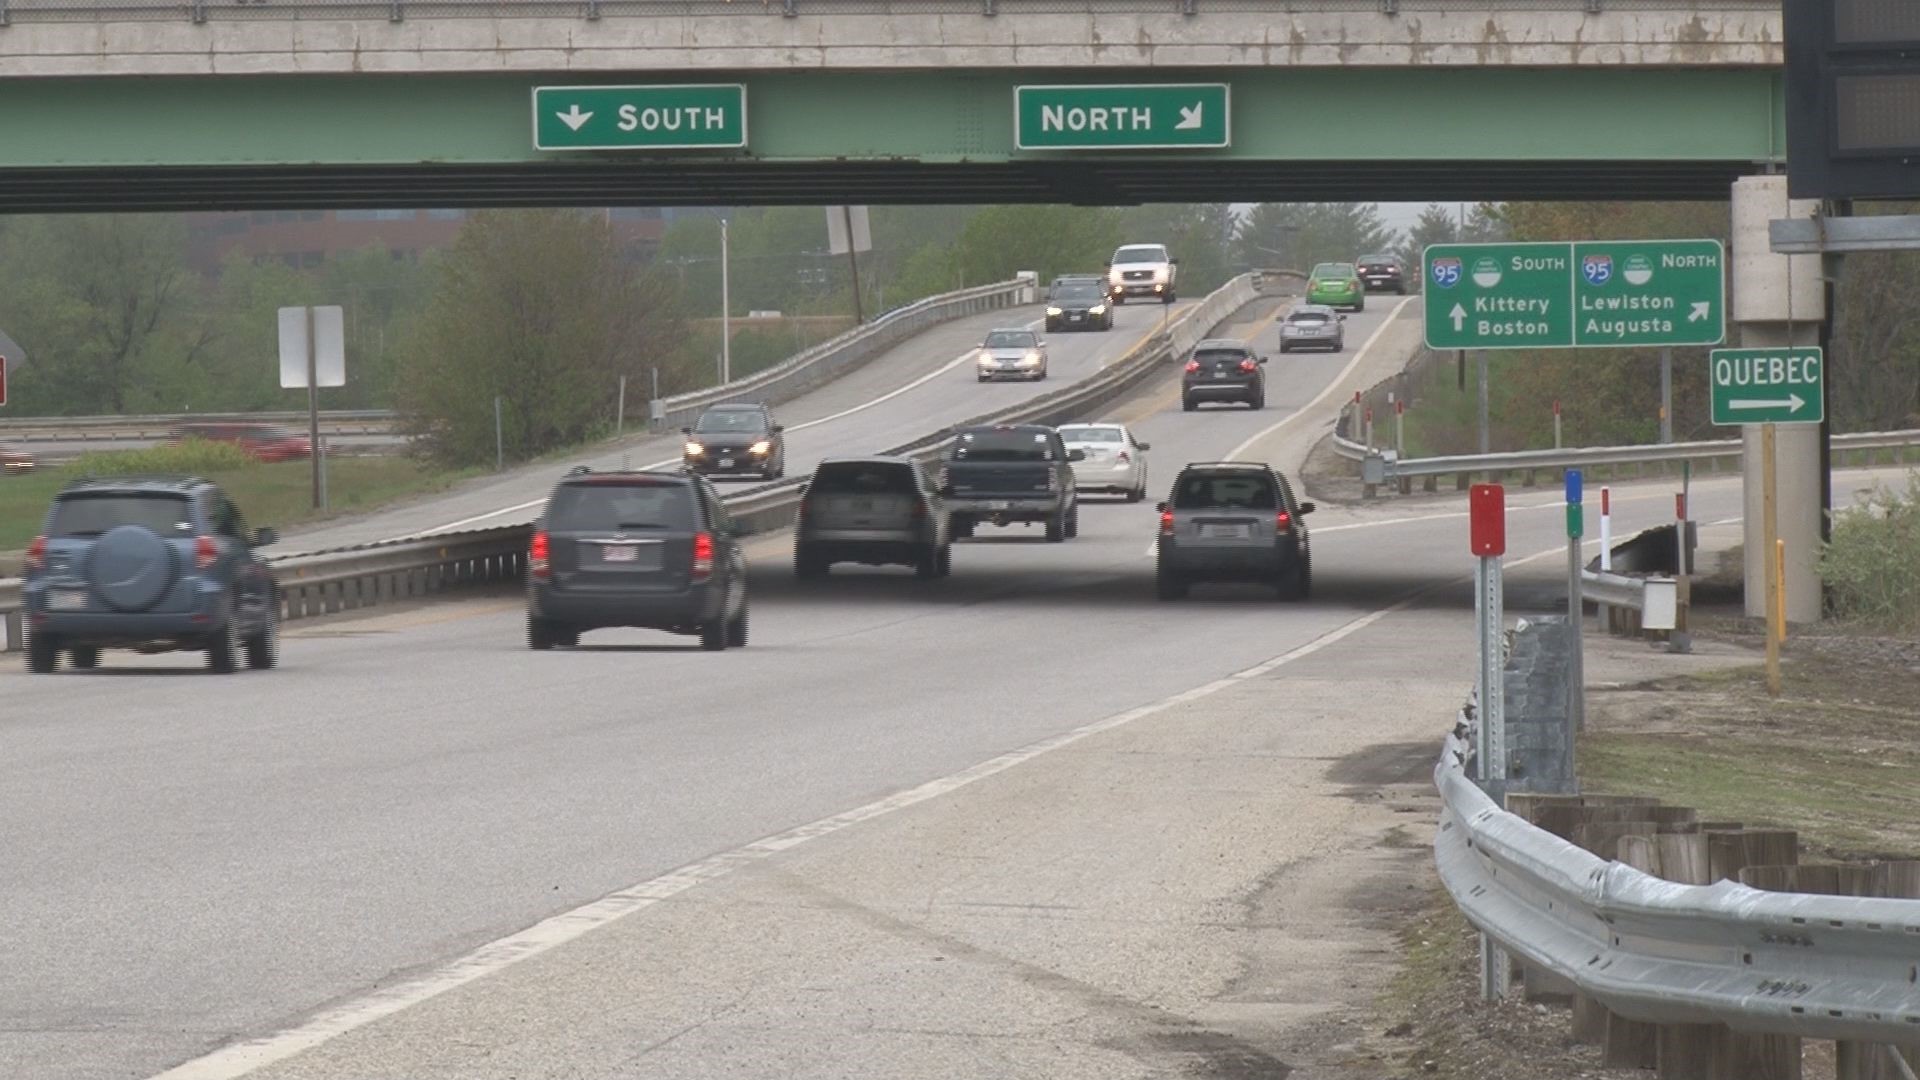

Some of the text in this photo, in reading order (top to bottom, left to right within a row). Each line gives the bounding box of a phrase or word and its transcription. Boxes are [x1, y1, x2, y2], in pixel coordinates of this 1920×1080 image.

[617, 103, 724, 132] SOUTH
[1042, 104, 1151, 132] NORTH
[1434, 265, 1458, 283] 95
[1511, 255, 1565, 271] SOUTH
[1585, 262, 1609, 280] 95
[1661, 253, 1717, 268] NORTH
[1475, 296, 1550, 316] Kittery
[1581, 294, 1675, 311] Lewiston
[1478, 320, 1549, 336] Boston
[1585, 317, 1673, 338] Augusta
[1715, 355, 1818, 386] QUEBEC
